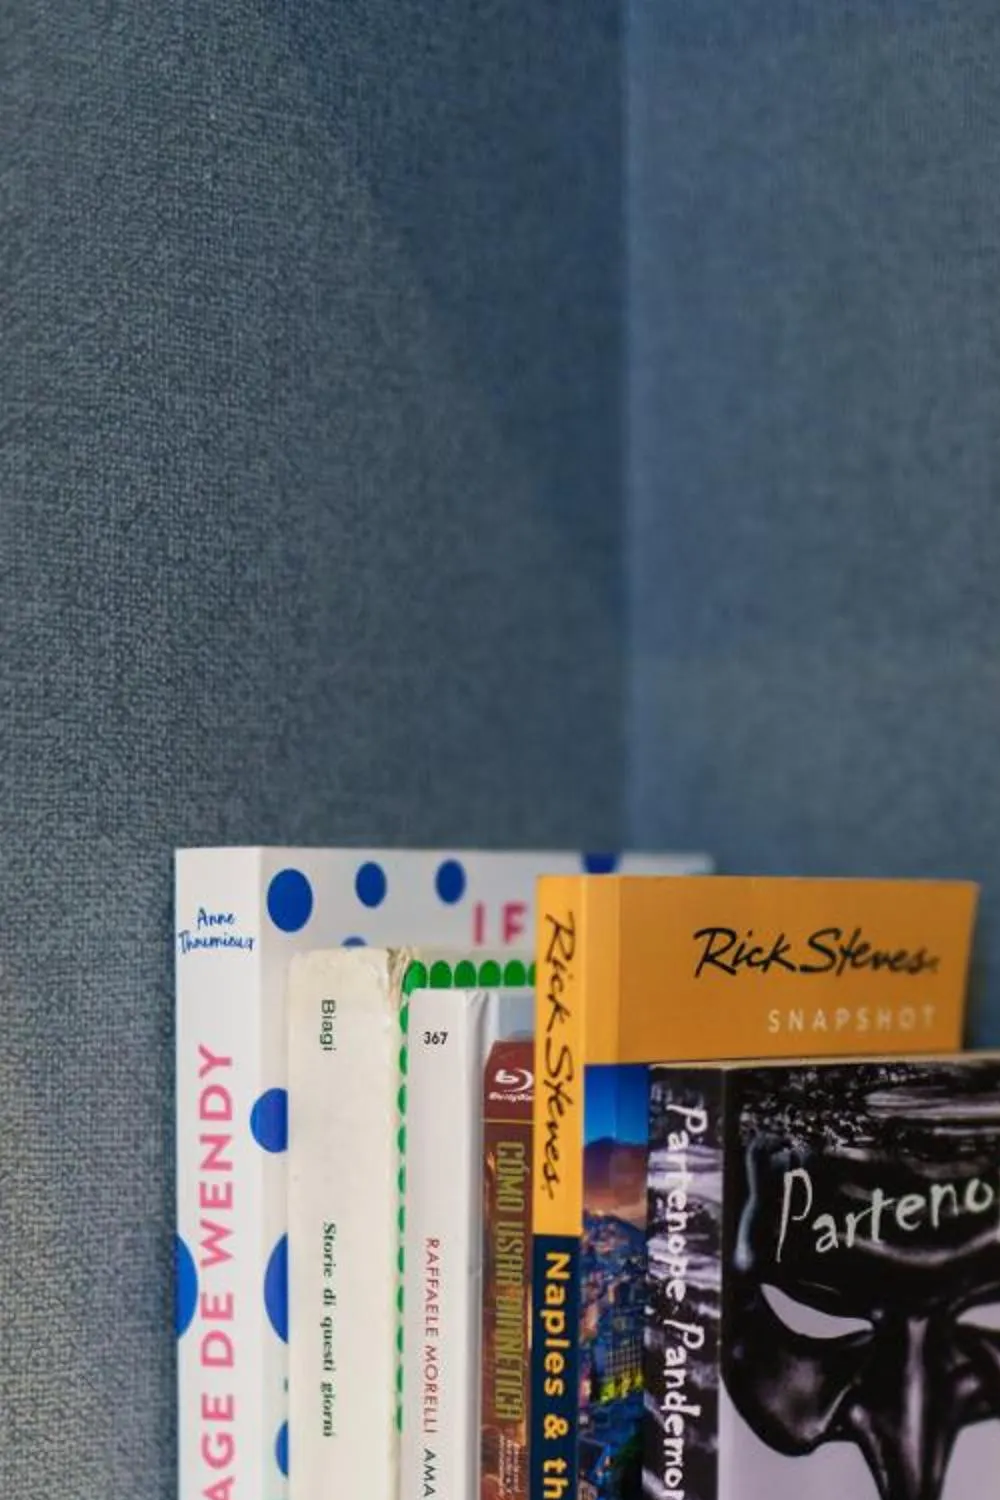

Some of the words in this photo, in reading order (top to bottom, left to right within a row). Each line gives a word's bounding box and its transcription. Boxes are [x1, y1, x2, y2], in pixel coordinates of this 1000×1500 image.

[197, 907, 235, 930] Anne
[544, 911, 575, 1033] Rick
[694, 926, 796, 978] Rick
[320, 1000, 337, 1052] Biagi
[423, 1031, 448, 1046] 367
[767, 1005, 937, 1034] SNAPSHOT
[198, 1044, 234, 1270] WENDY
[665, 1104, 708, 1303] Partenope
[323, 1222, 336, 1278] Storie
[323, 1287, 336, 1306] di
[424, 1237, 440, 1337] RAFFAELE
[201, 1290, 234, 1368] DE
[320, 1316, 336, 1373] questi
[539, 1252, 571, 1397] Naples
[320, 1381, 336, 1438] giorni
[422, 1345, 439, 1434] MORELLI
[543, 1414, 569, 1440] &
[422, 1448, 437, 1498] AMA
